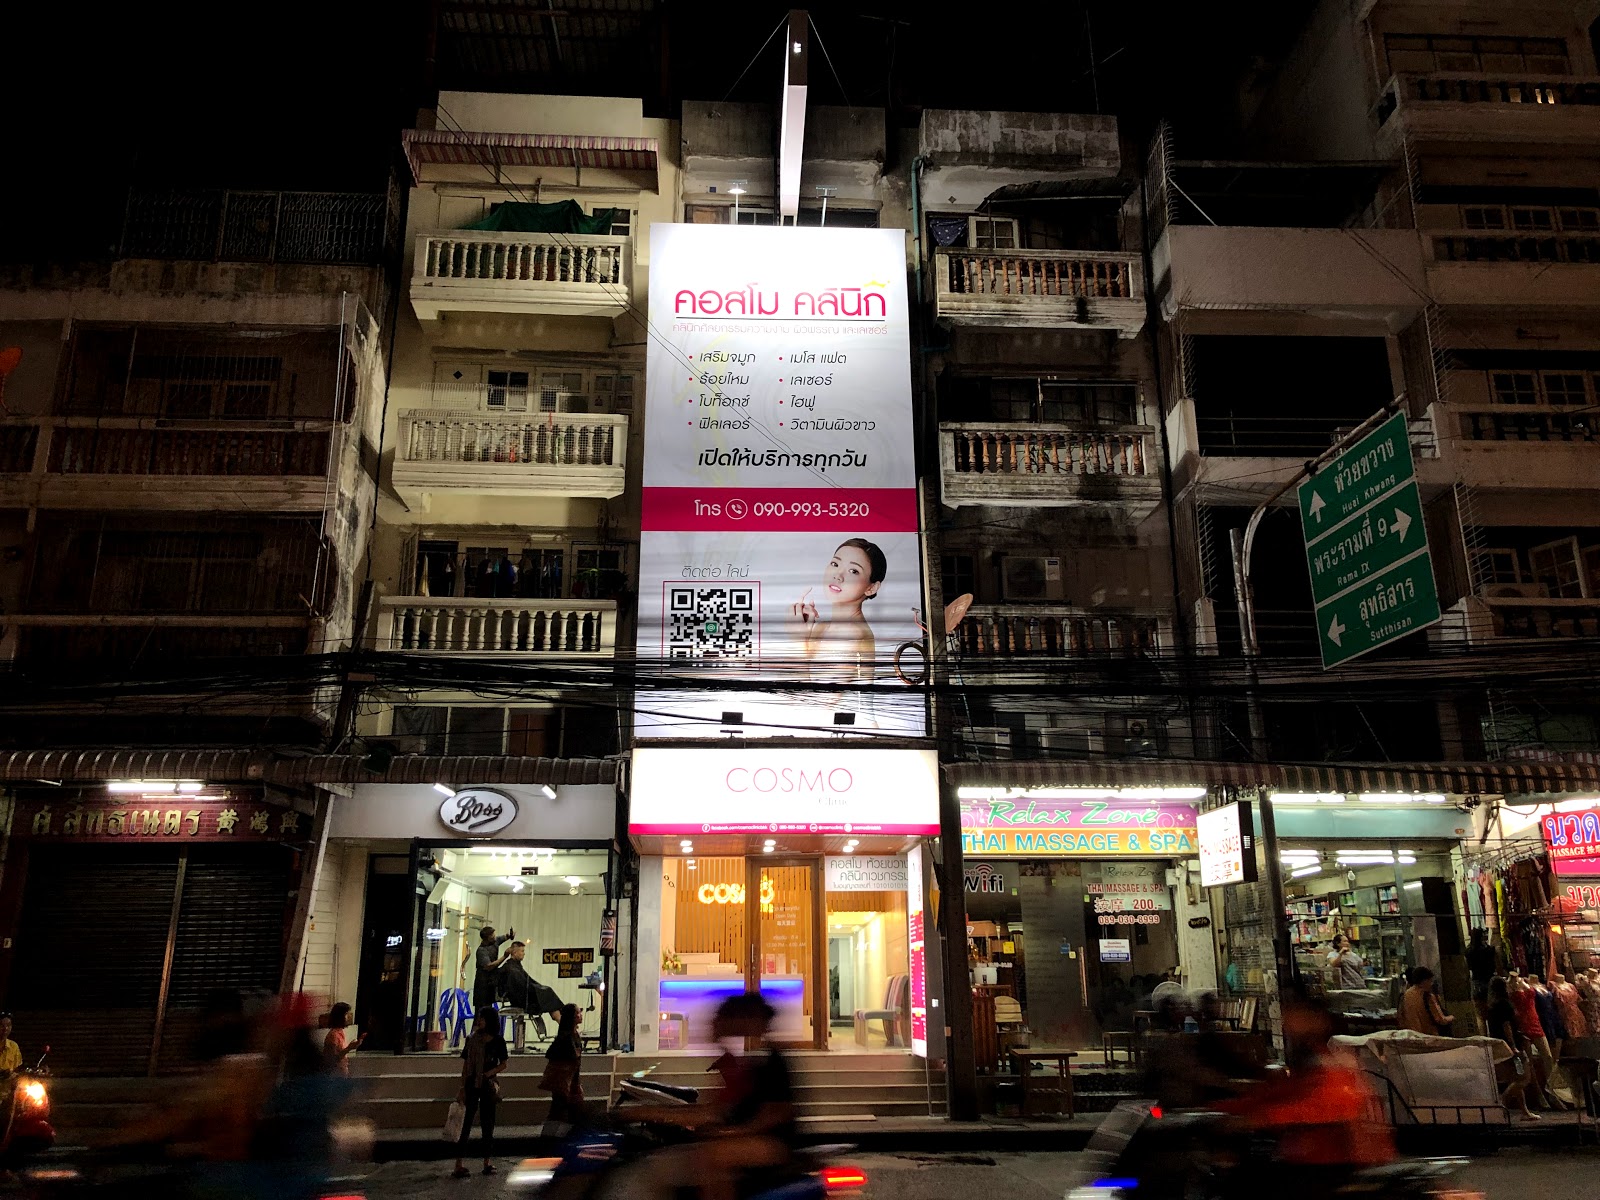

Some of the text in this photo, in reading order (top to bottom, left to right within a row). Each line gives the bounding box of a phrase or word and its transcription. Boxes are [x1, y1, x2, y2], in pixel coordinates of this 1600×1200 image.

[675, 283, 887, 317] คอสโม คลินิก
[699, 350, 756, 366] เสริมจมูก
[790, 351, 815, 364] เมโส
[699, 372, 750, 385] ร้อยไหม
[790, 373, 833, 386] เลเซอร์
[699, 393, 751, 408] โบท็อกซ์
[698, 416, 751, 430] ฟิลเลอร์
[790, 418, 876, 431] วิตามินผิวขาว
[698, 448, 868, 472] เปิดให้บริการทุกวัน
[1333, 438, 1395, 493] ห้วยขวาง
[1342, 474, 1396, 515] Huai Khwang
[694, 500, 870, 517] โทร 090-993-5320
[1314, 512, 1387, 575] พระรามที่ 9
[681, 563, 750, 578] ติดต่อ ไลน์
[1337, 561, 1371, 587] Rama IX
[1359, 577, 1415, 628] สุทธิสาร
[1370, 616, 1412, 642] Sutthisan
[726, 767, 853, 793] COSMO
[450, 796, 503, 829] Boss
[986, 800, 1158, 825] Relax Zone
[962, 834, 1006, 851] THAI
[1016, 834, 1120, 851] MASSAGE
[1128, 834, 1142, 851] &
[1149, 834, 1191, 851] SPA
[1549, 846, 1585, 857] MASSAGE
[830, 857, 862, 869] คอสโม
[1107, 866, 1133, 878] Relax
[1138, 866, 1164, 877] Zone
[1087, 883, 1164, 893] THAI MASSAGE & SPA
[1094, 897, 1125, 913] 按摩
[1097, 915, 1160, 925] 089-030-8999
